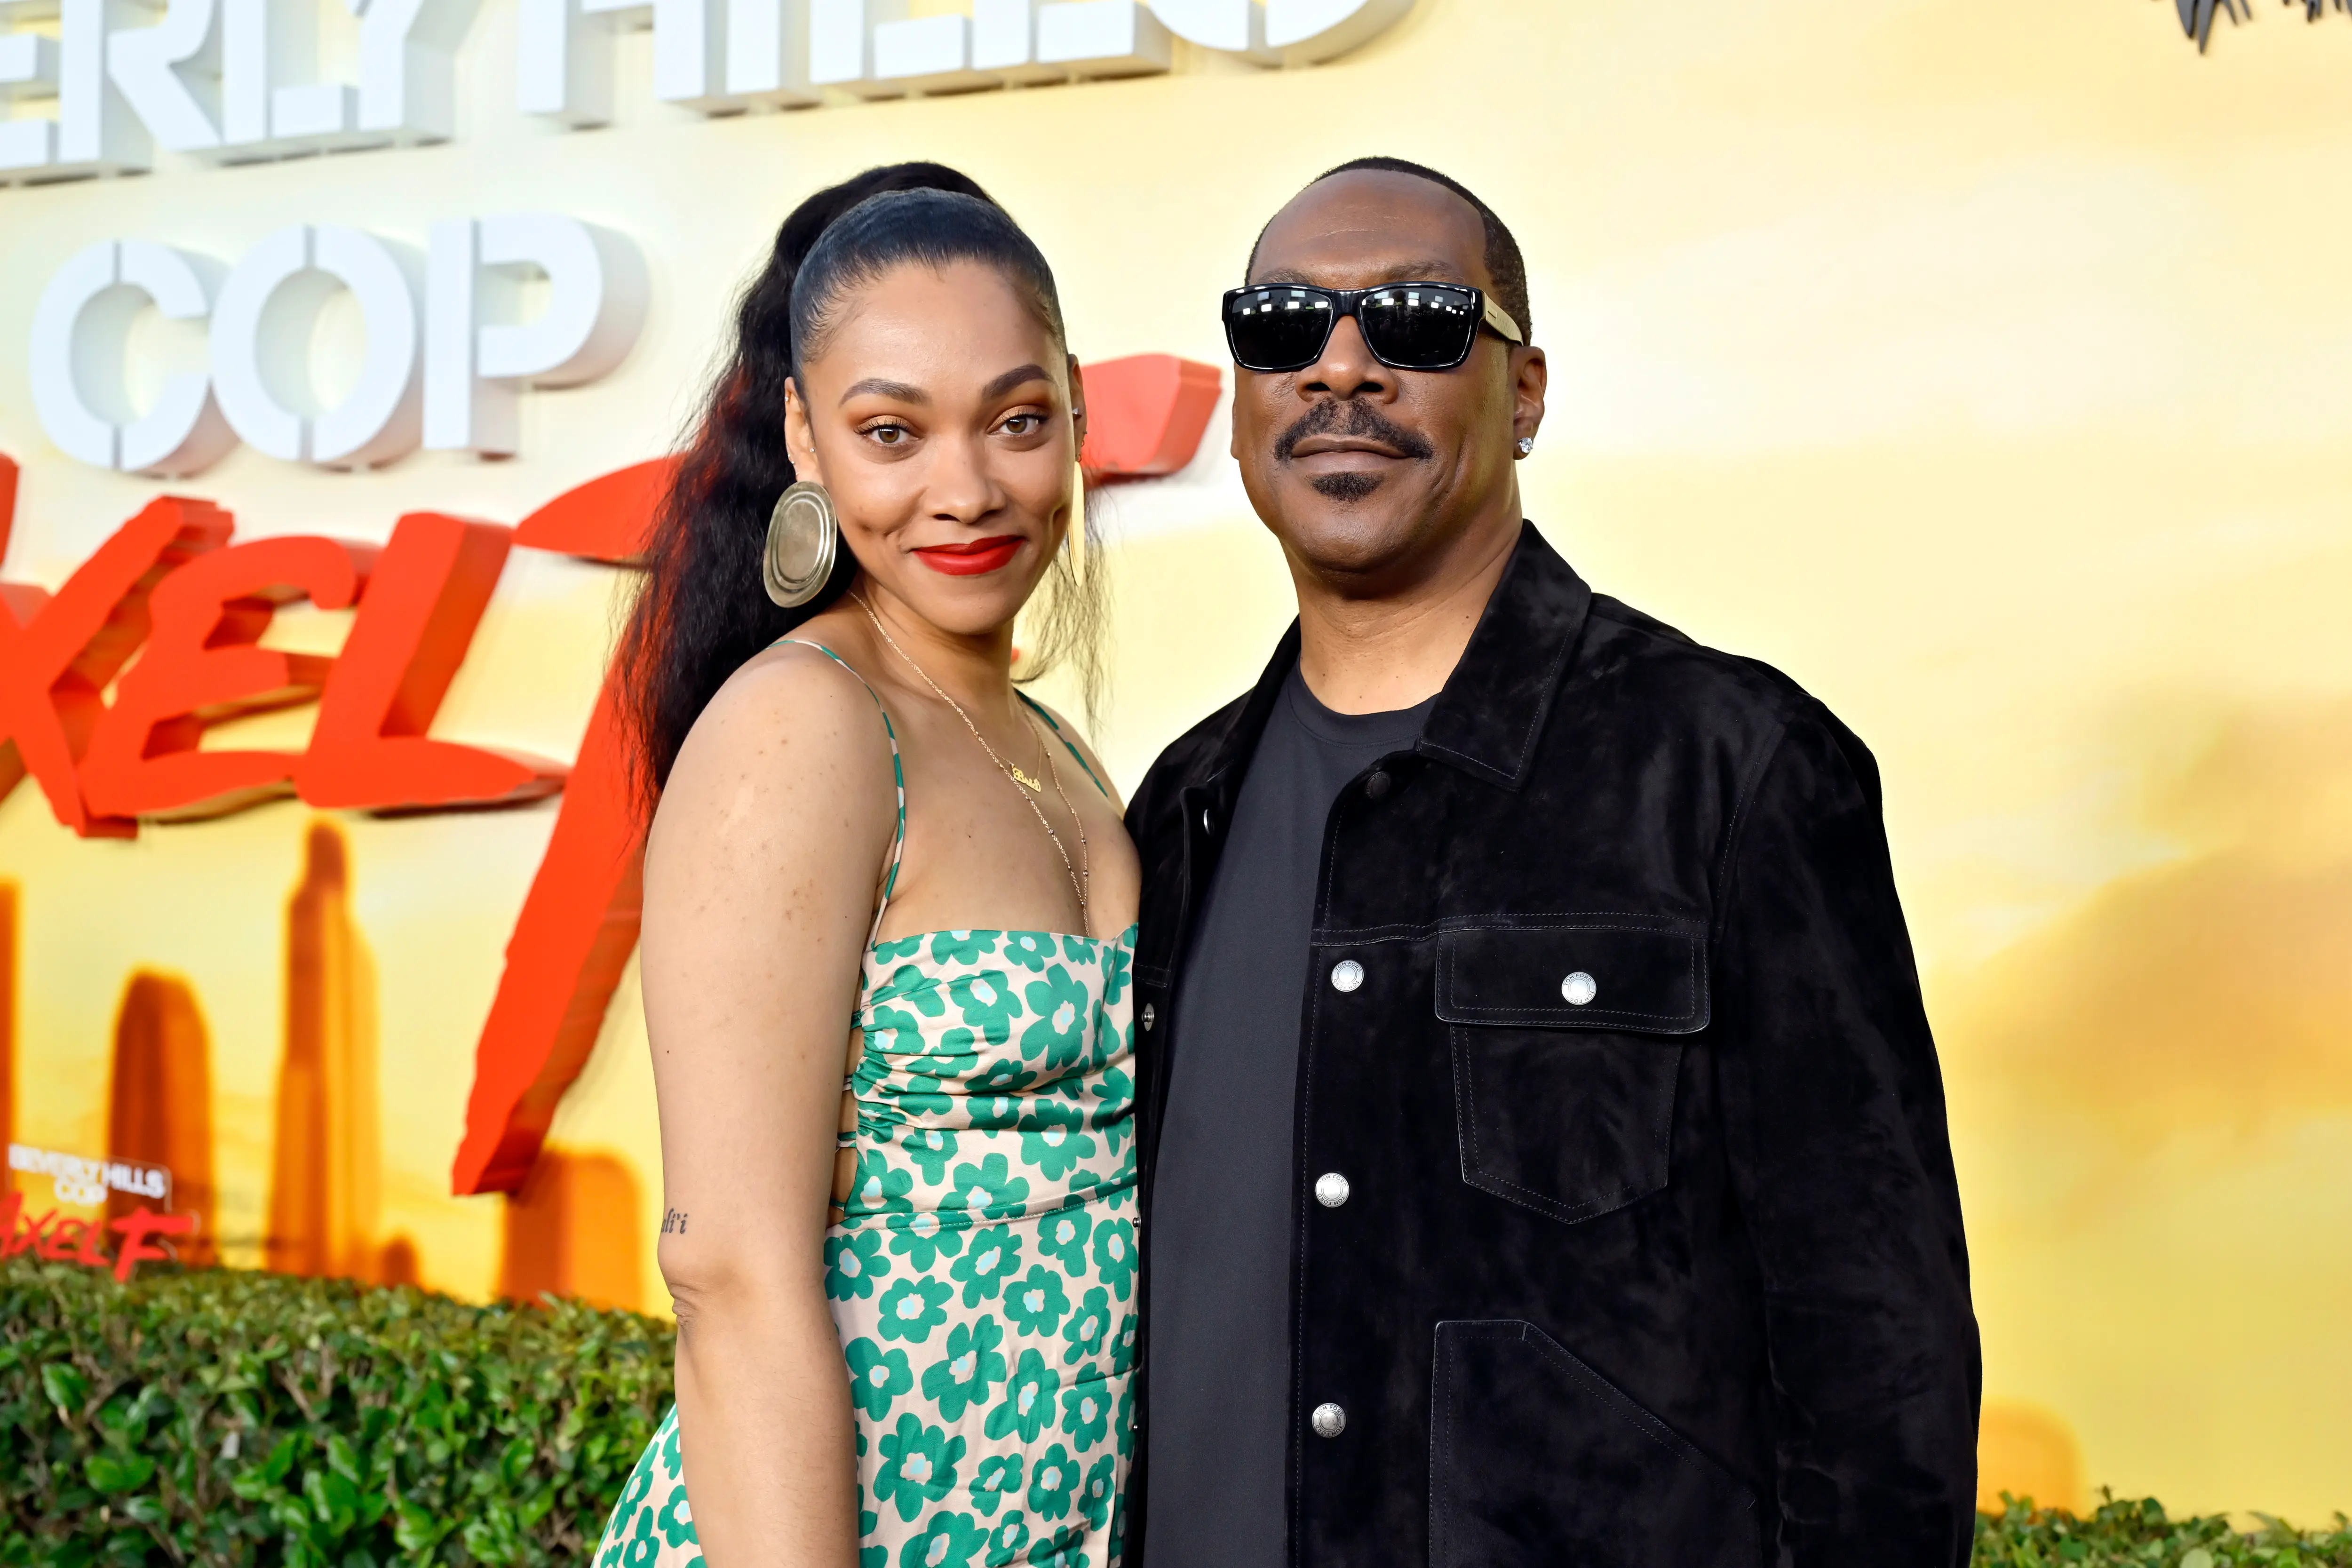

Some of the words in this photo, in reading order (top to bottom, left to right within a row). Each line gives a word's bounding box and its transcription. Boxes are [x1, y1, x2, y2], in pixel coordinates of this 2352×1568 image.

[29, 212, 604, 472] COP
[0, 452, 539, 833] XEL
[1348, 962, 1361, 972] FORD
[1564, 975, 1574, 985] TOM
[1584, 991, 1594, 1002] TOM
[1333, 1175, 1346, 1186] FORD
[1318, 1194, 1332, 1205] FORD
[1333, 1196, 1346, 1205] TOM
[1316, 1406, 1327, 1416] TOM
[1329, 1405, 1343, 1417] FORD
